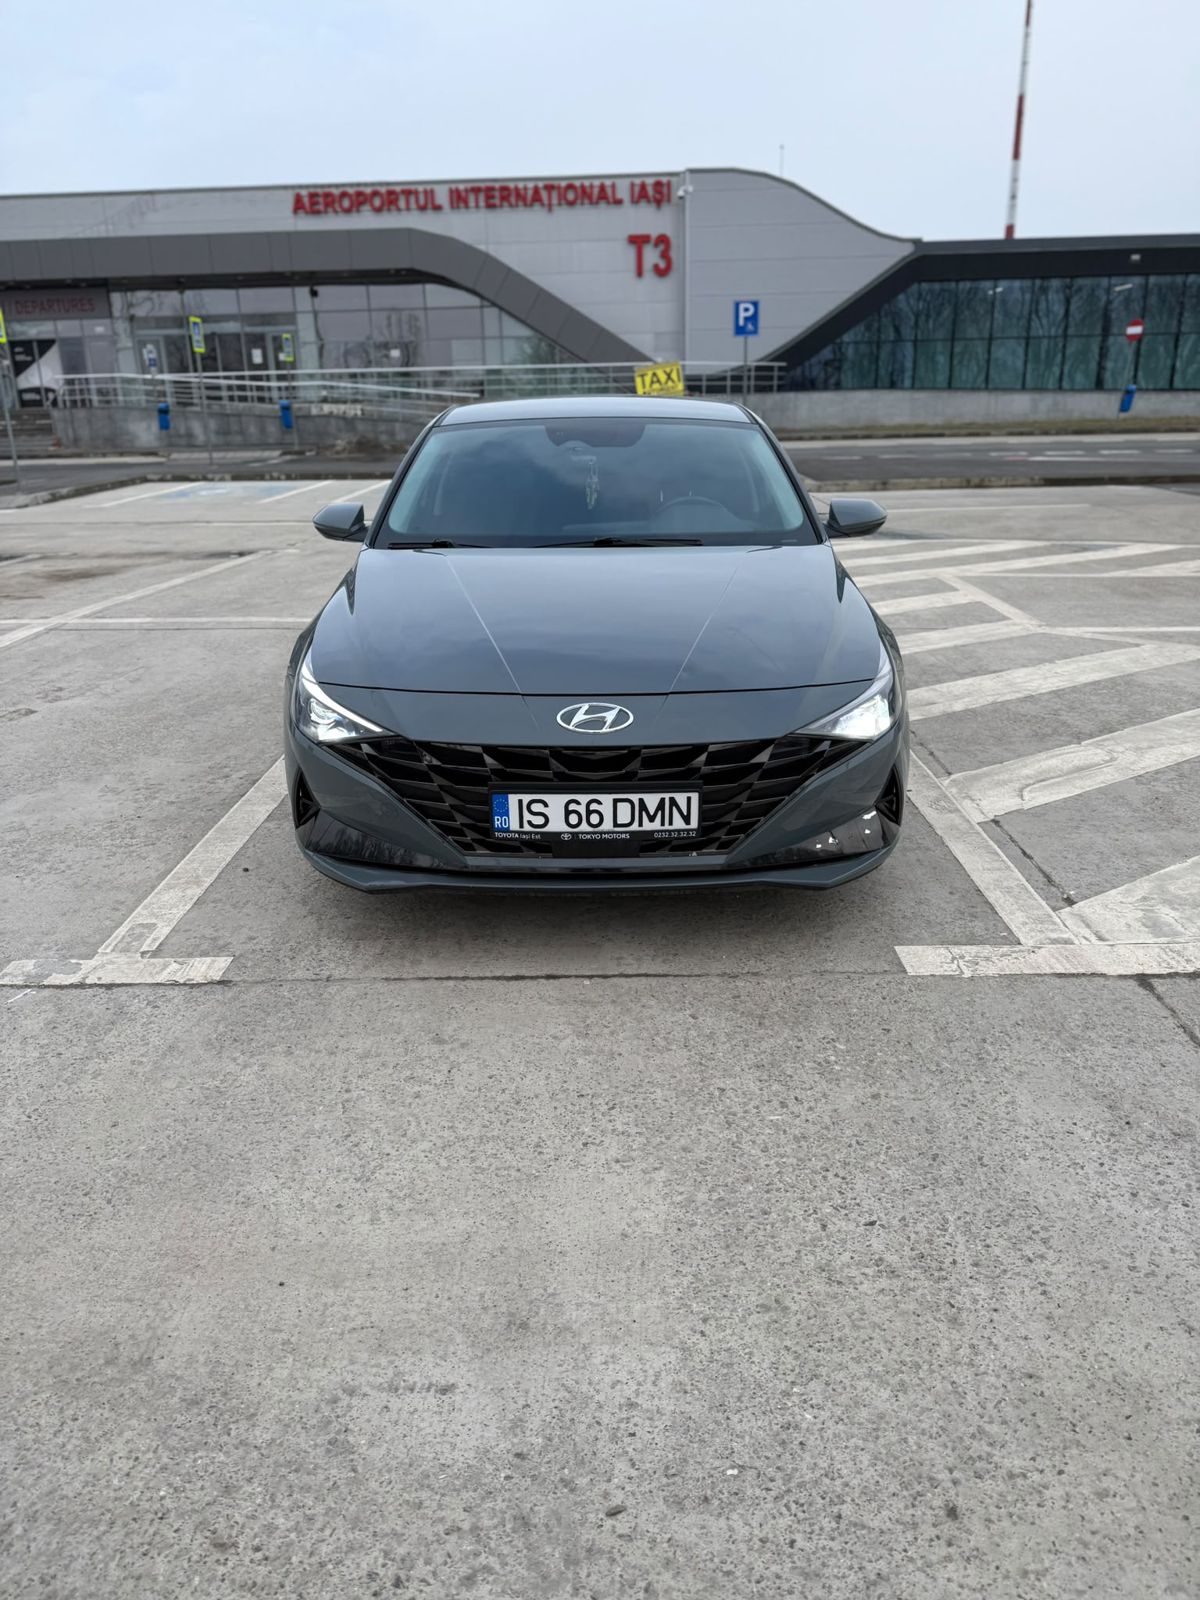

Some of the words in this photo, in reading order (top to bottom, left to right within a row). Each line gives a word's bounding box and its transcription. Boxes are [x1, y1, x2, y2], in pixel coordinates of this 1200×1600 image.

[292, 188, 444, 215] AEROPORTUL
[448, 182, 623, 212] INTERNAȚIONAL
[629, 179, 672, 210] IAȘI
[627, 233, 673, 278] T3
[15, 298, 96, 314] DEPARTURES
[738, 302, 755, 327] P
[637, 367, 681, 389] TAXI
[494, 815, 509, 829] RO
[517, 798, 550, 829] IS
[563, 798, 605, 829] 66
[612, 796, 692, 829] DMN
